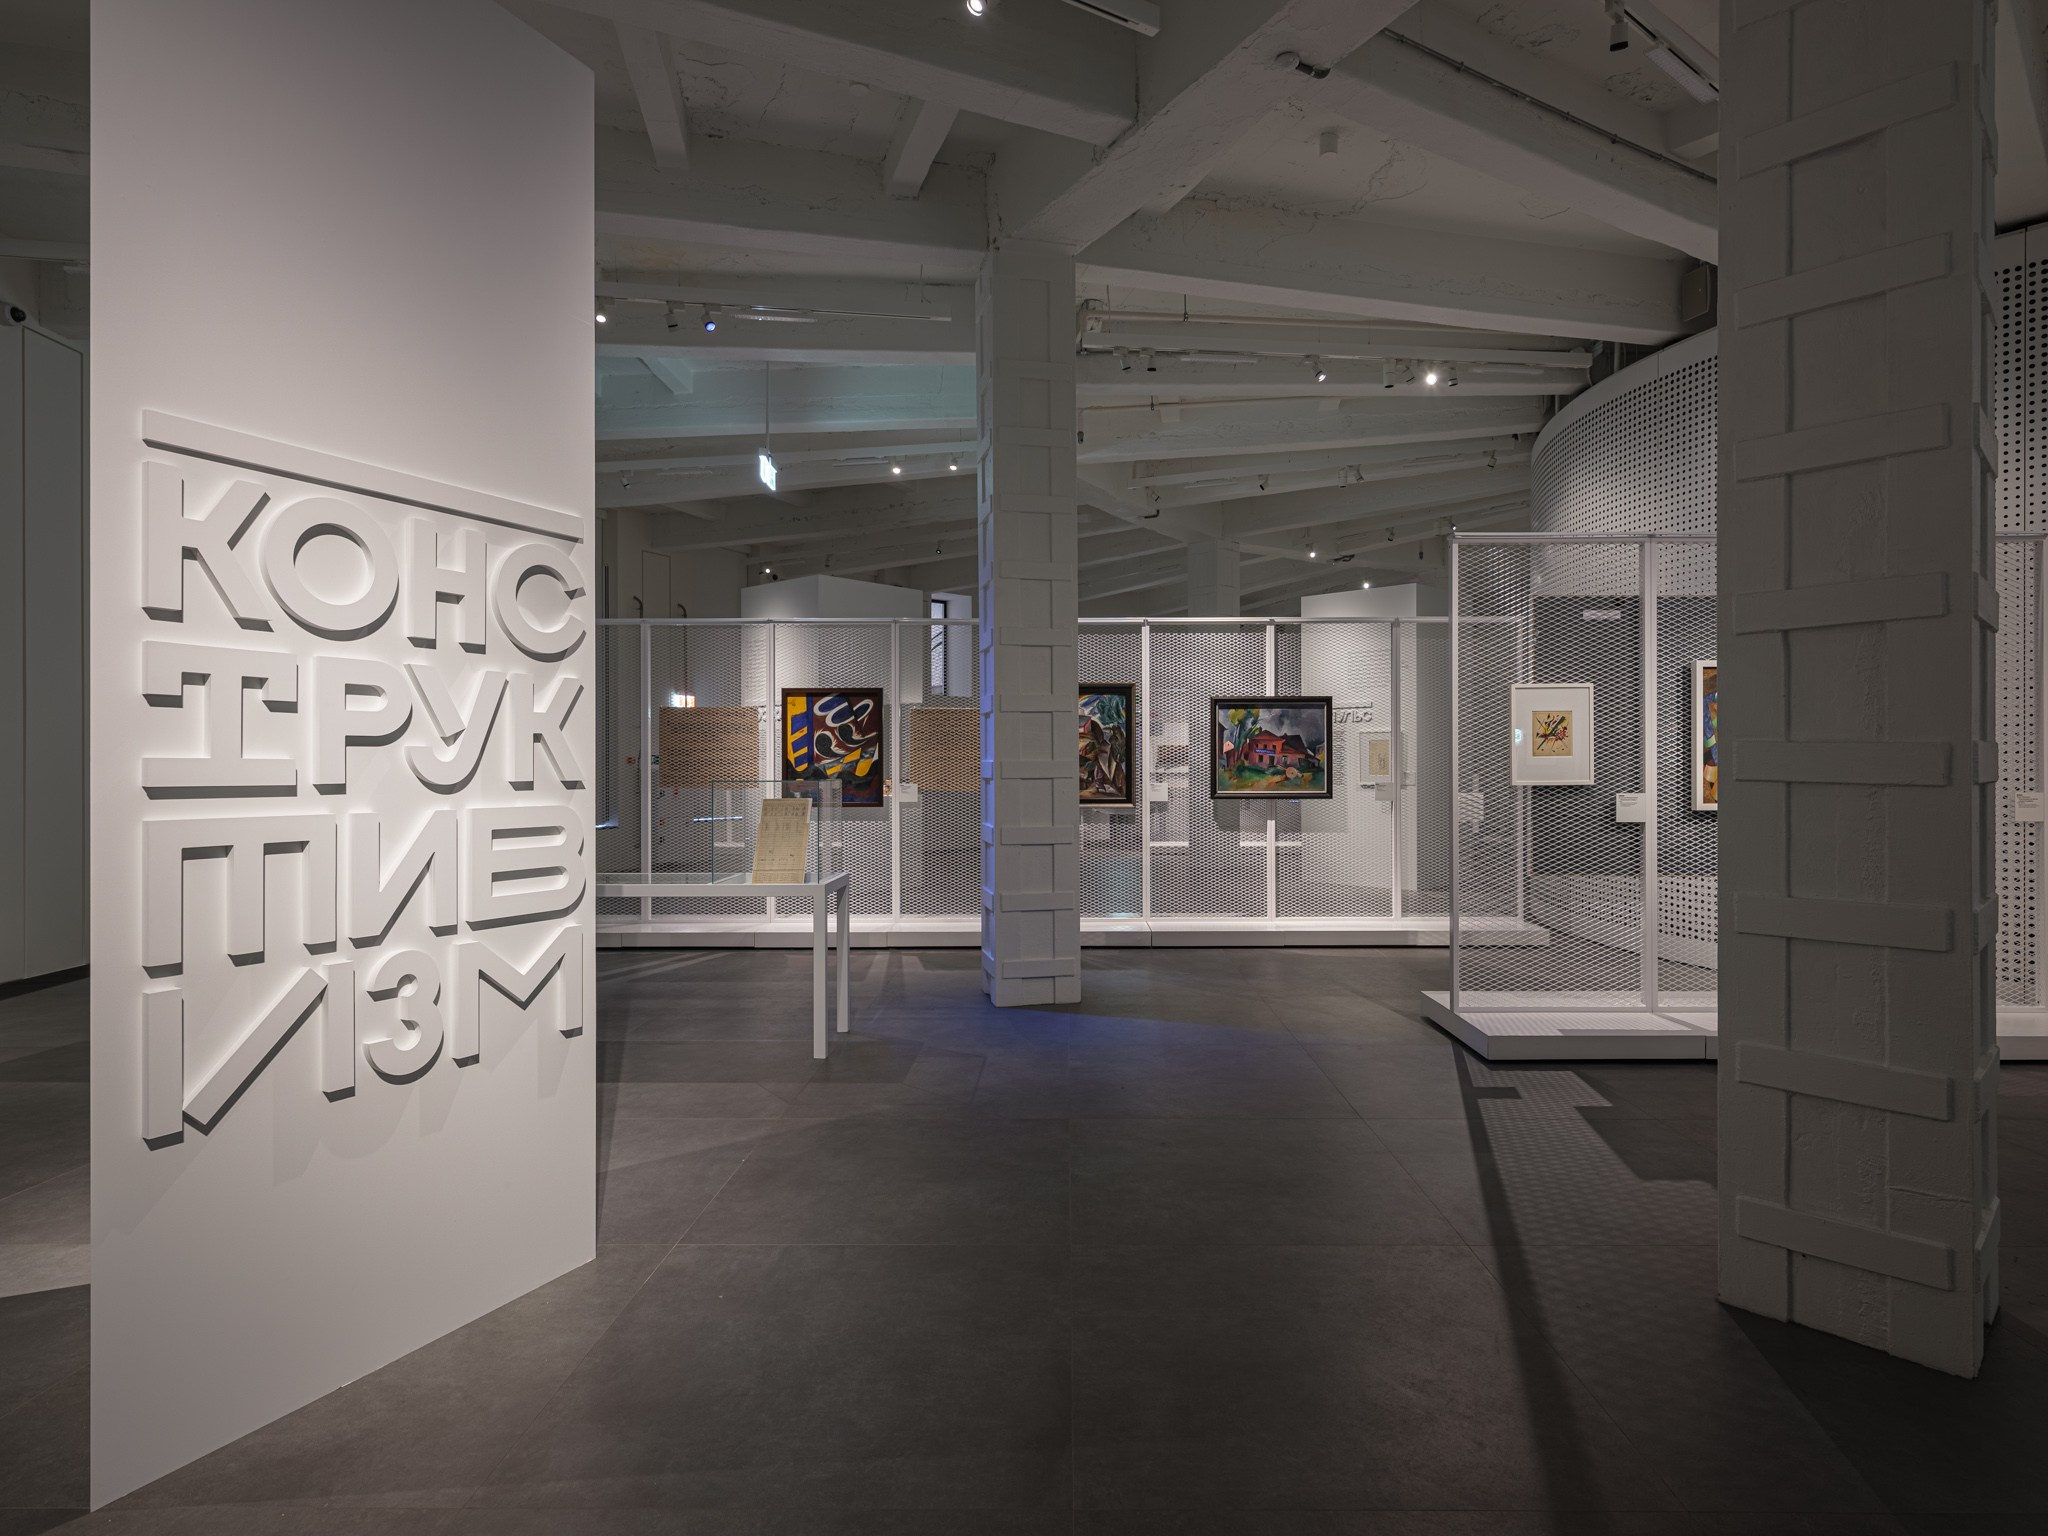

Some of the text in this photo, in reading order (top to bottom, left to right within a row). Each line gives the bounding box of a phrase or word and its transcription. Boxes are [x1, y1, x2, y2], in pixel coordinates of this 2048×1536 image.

[142, 461, 586, 655] КОНС
[142, 641, 586, 799] ТРУК
[142, 805, 586, 979] ТИВ
[142, 924, 584, 1151] ИЗМ
